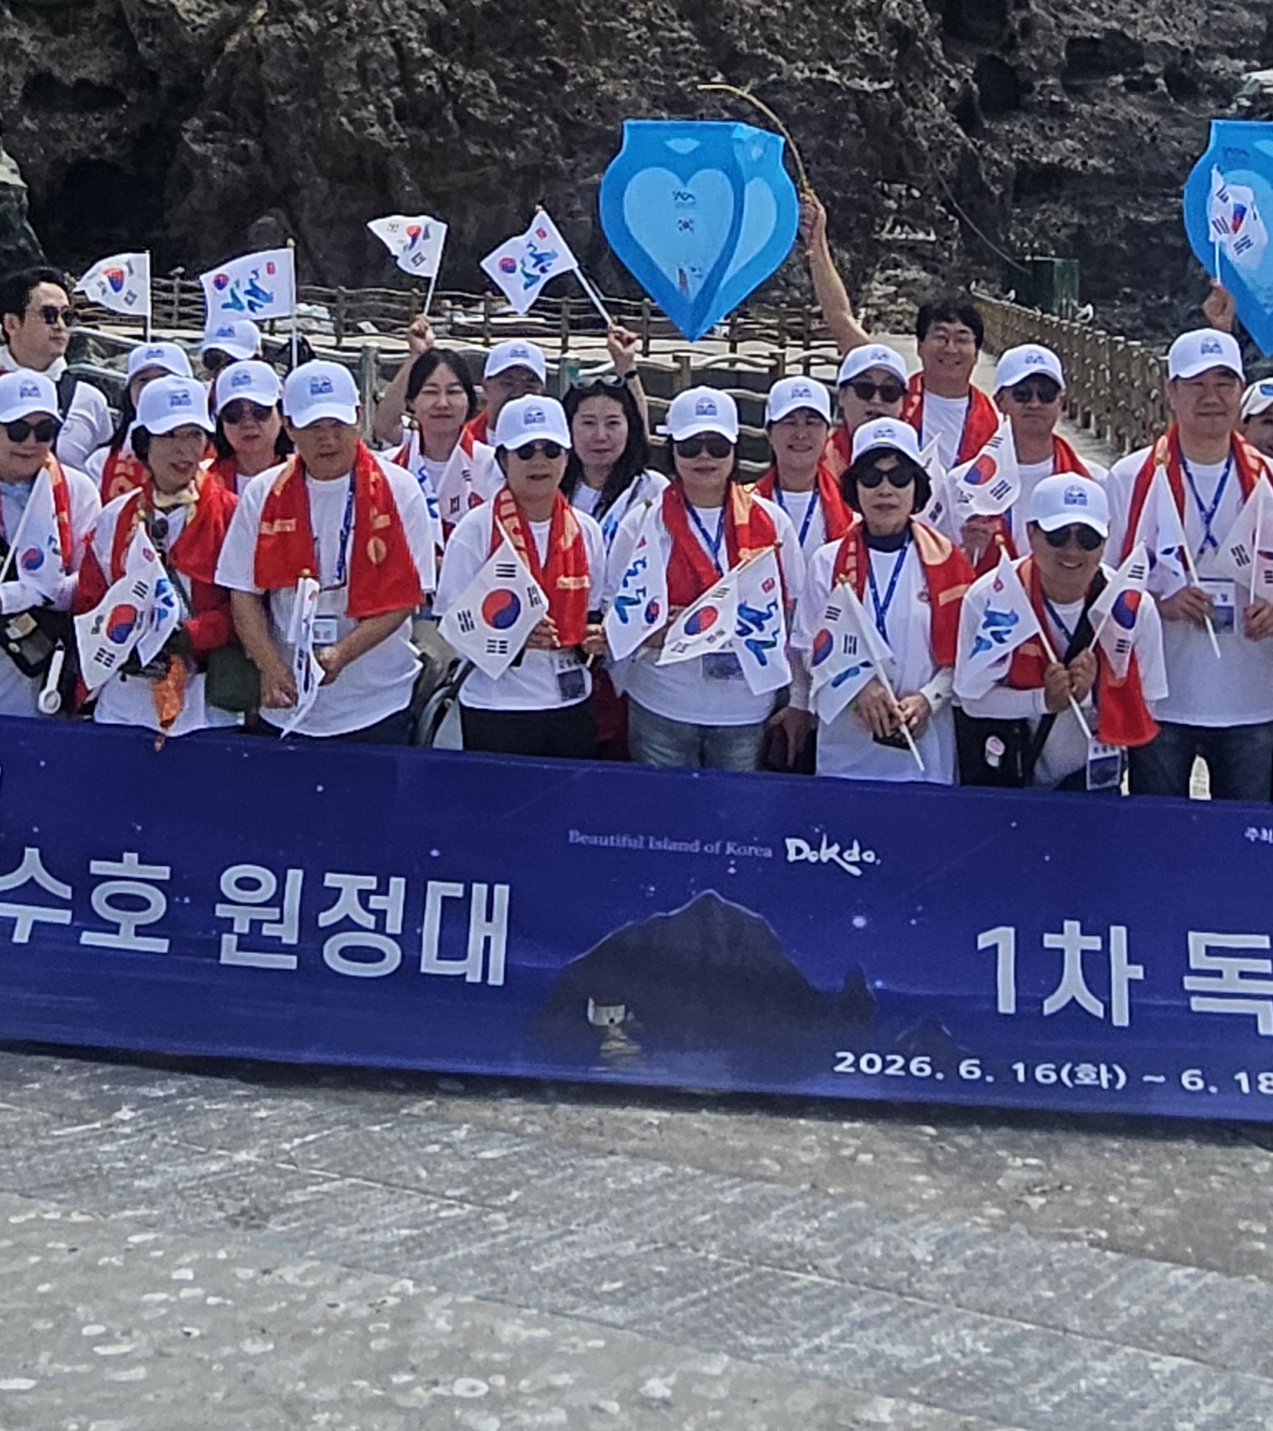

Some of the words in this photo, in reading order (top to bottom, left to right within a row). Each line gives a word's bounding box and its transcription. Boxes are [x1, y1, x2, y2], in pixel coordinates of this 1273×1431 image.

[568, 829, 644, 850] Beautiful
[648, 836, 700, 853] Island
[703, 840, 722, 855] of
[726, 840, 773, 858] Korea
[214, 863, 511, 987] 원정대
[976, 920, 1145, 1028] 1차
[832, 1051, 945, 1081] 2026.
[958, 1058, 996, 1084] 6.
[1011, 1061, 1128, 1091] 16(화)
[1179, 1067, 1220, 1095] 6.
